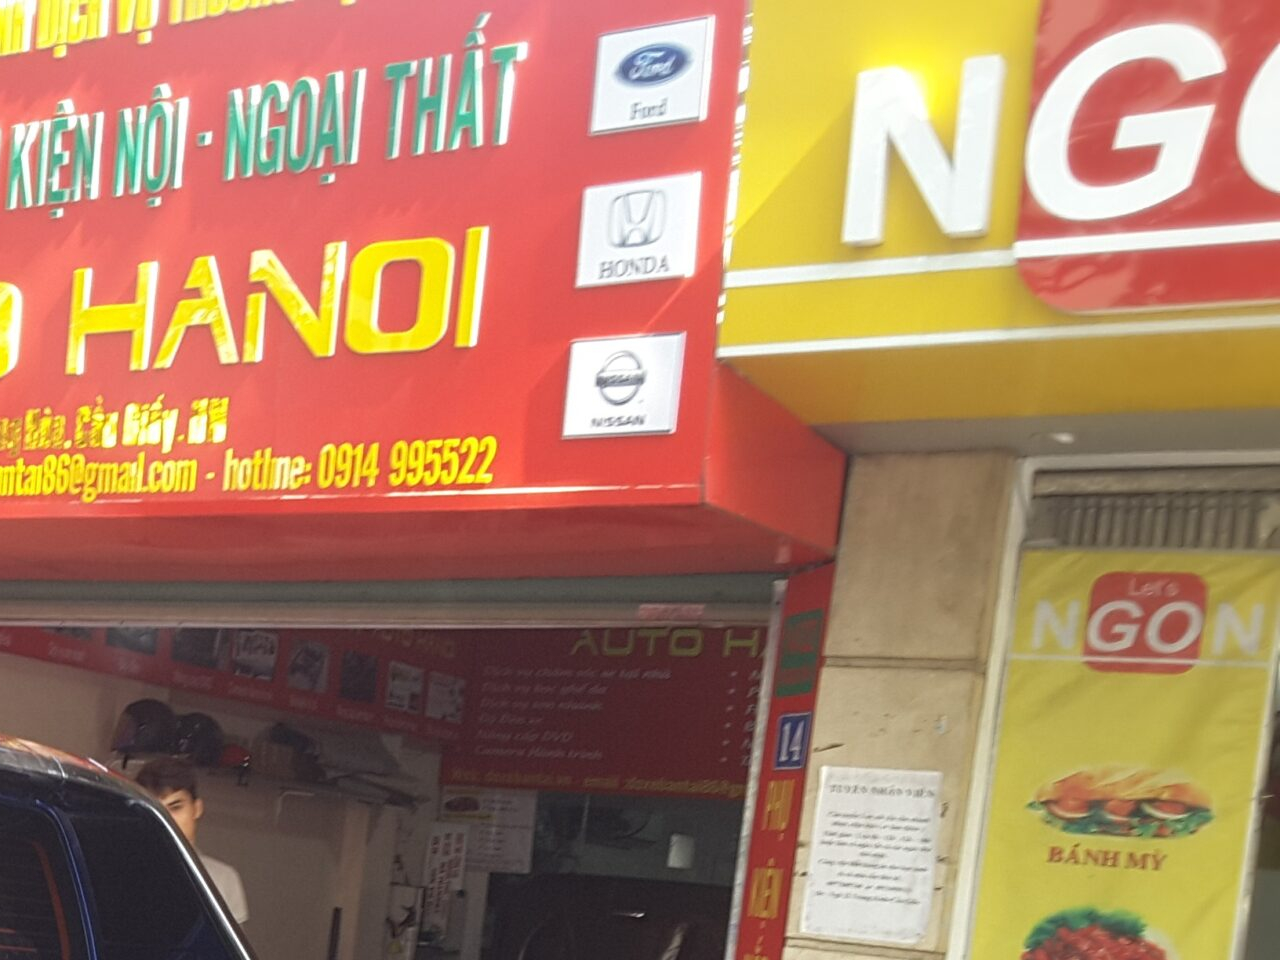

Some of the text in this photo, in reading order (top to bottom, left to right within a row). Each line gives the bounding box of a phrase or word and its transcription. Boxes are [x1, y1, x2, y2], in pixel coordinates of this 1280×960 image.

[6, 99, 104, 218] KIỆN
[113, 83, 190, 208] NỘI
[223, 68, 367, 184] NGOẠI
[383, 12, 528, 160] THẤT
[629, 98, 668, 121] Ford
[839, 22, 1280, 248] NG
[598, 255, 670, 280] HONDA
[65, 226, 490, 375] HANOI
[590, 414, 646, 429] NISSAN
[222, 447, 312, 491] hotline:
[317, 442, 380, 488] 0914
[388, 435, 497, 487] 995522
[570, 628, 703, 657] AUTO
[778, 720, 805, 763] 14
[1046, 842, 1121, 868] BÁNH
